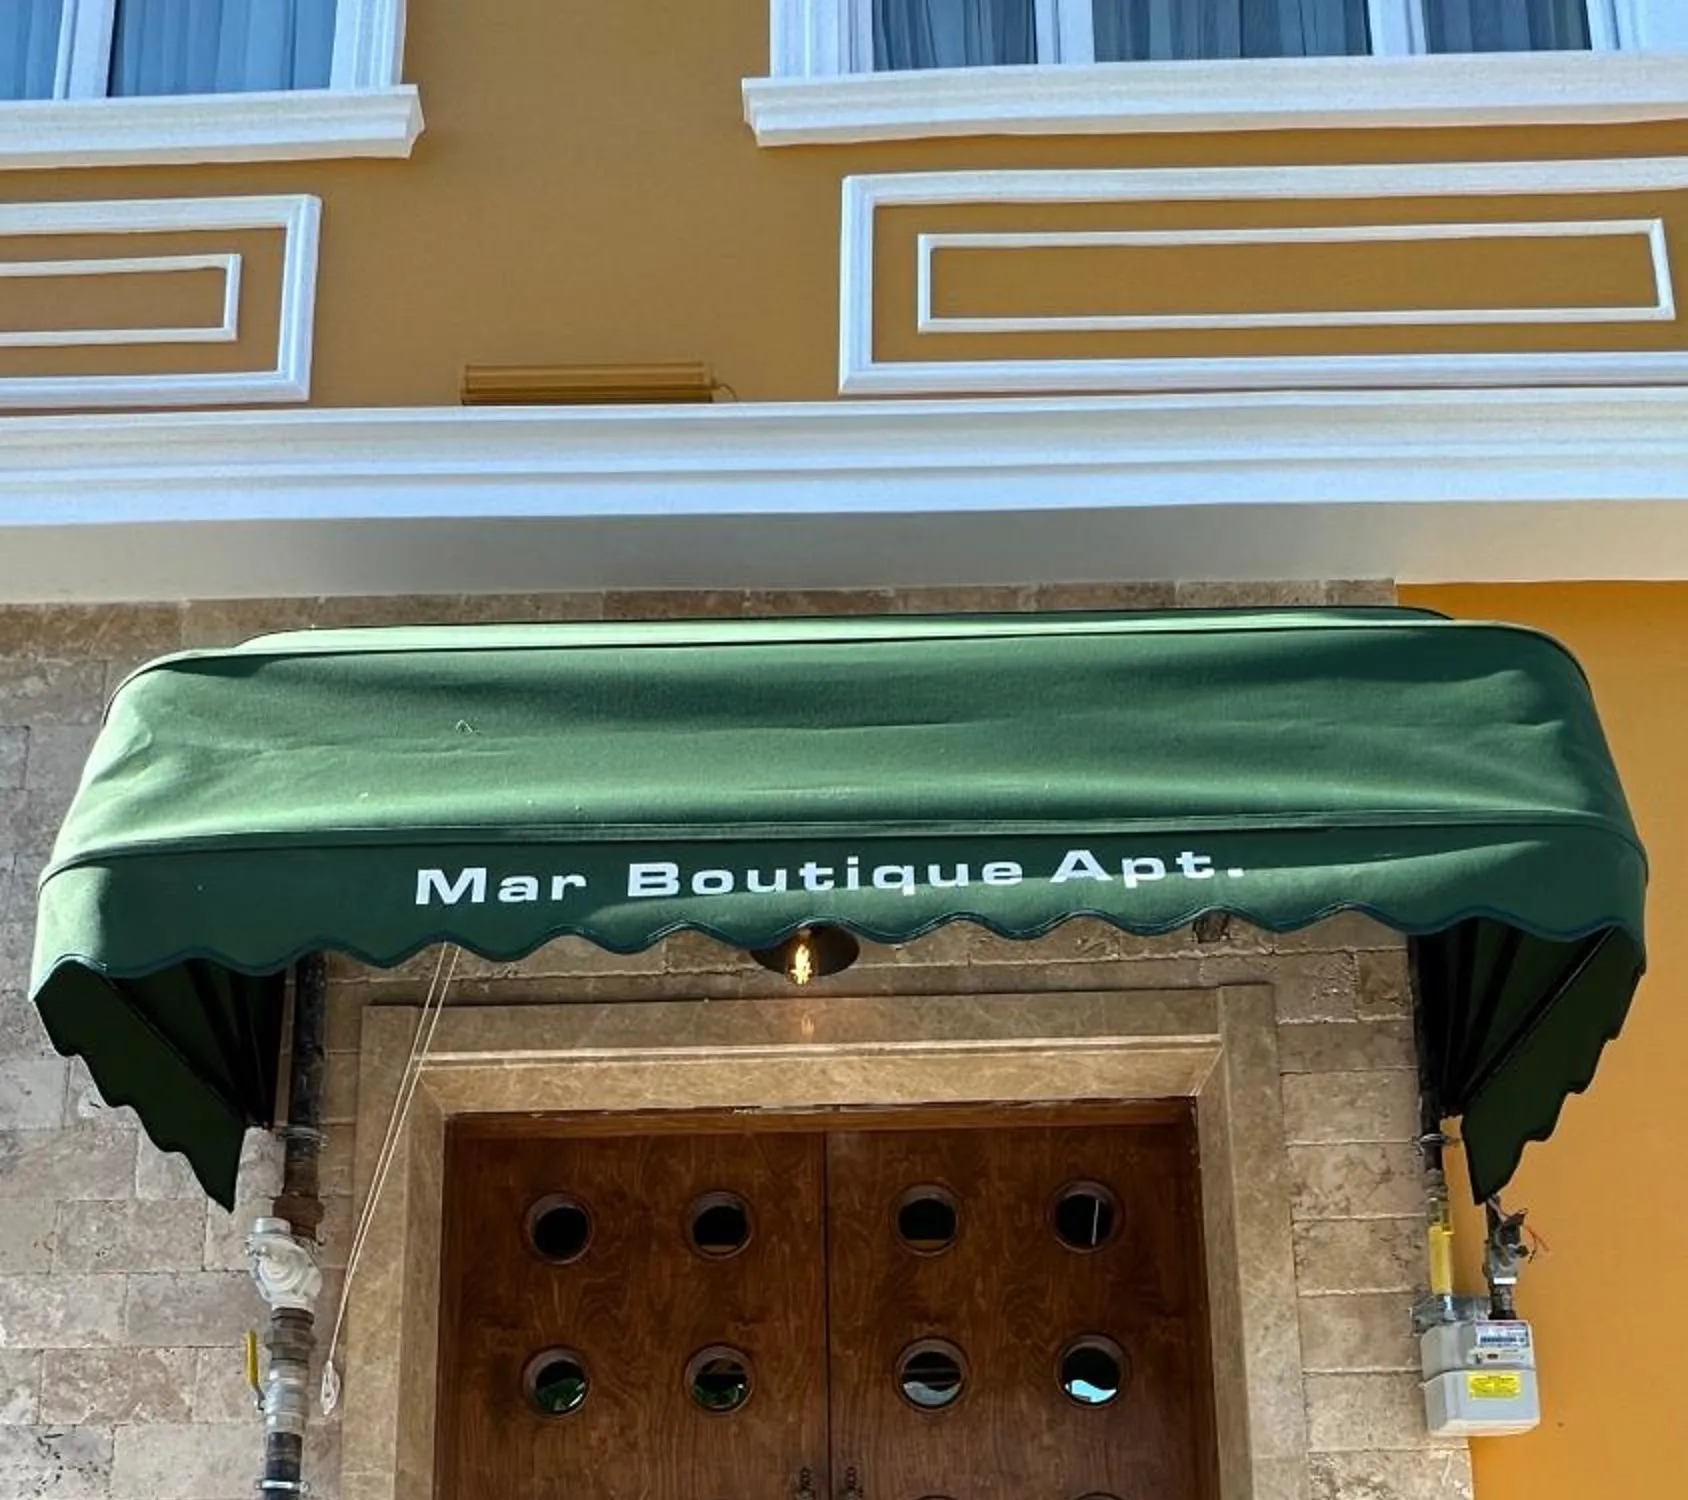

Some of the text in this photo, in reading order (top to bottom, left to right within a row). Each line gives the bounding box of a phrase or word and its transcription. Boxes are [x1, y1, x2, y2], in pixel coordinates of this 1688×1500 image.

[414, 849, 1246, 906] Mar Boutique Apt.
